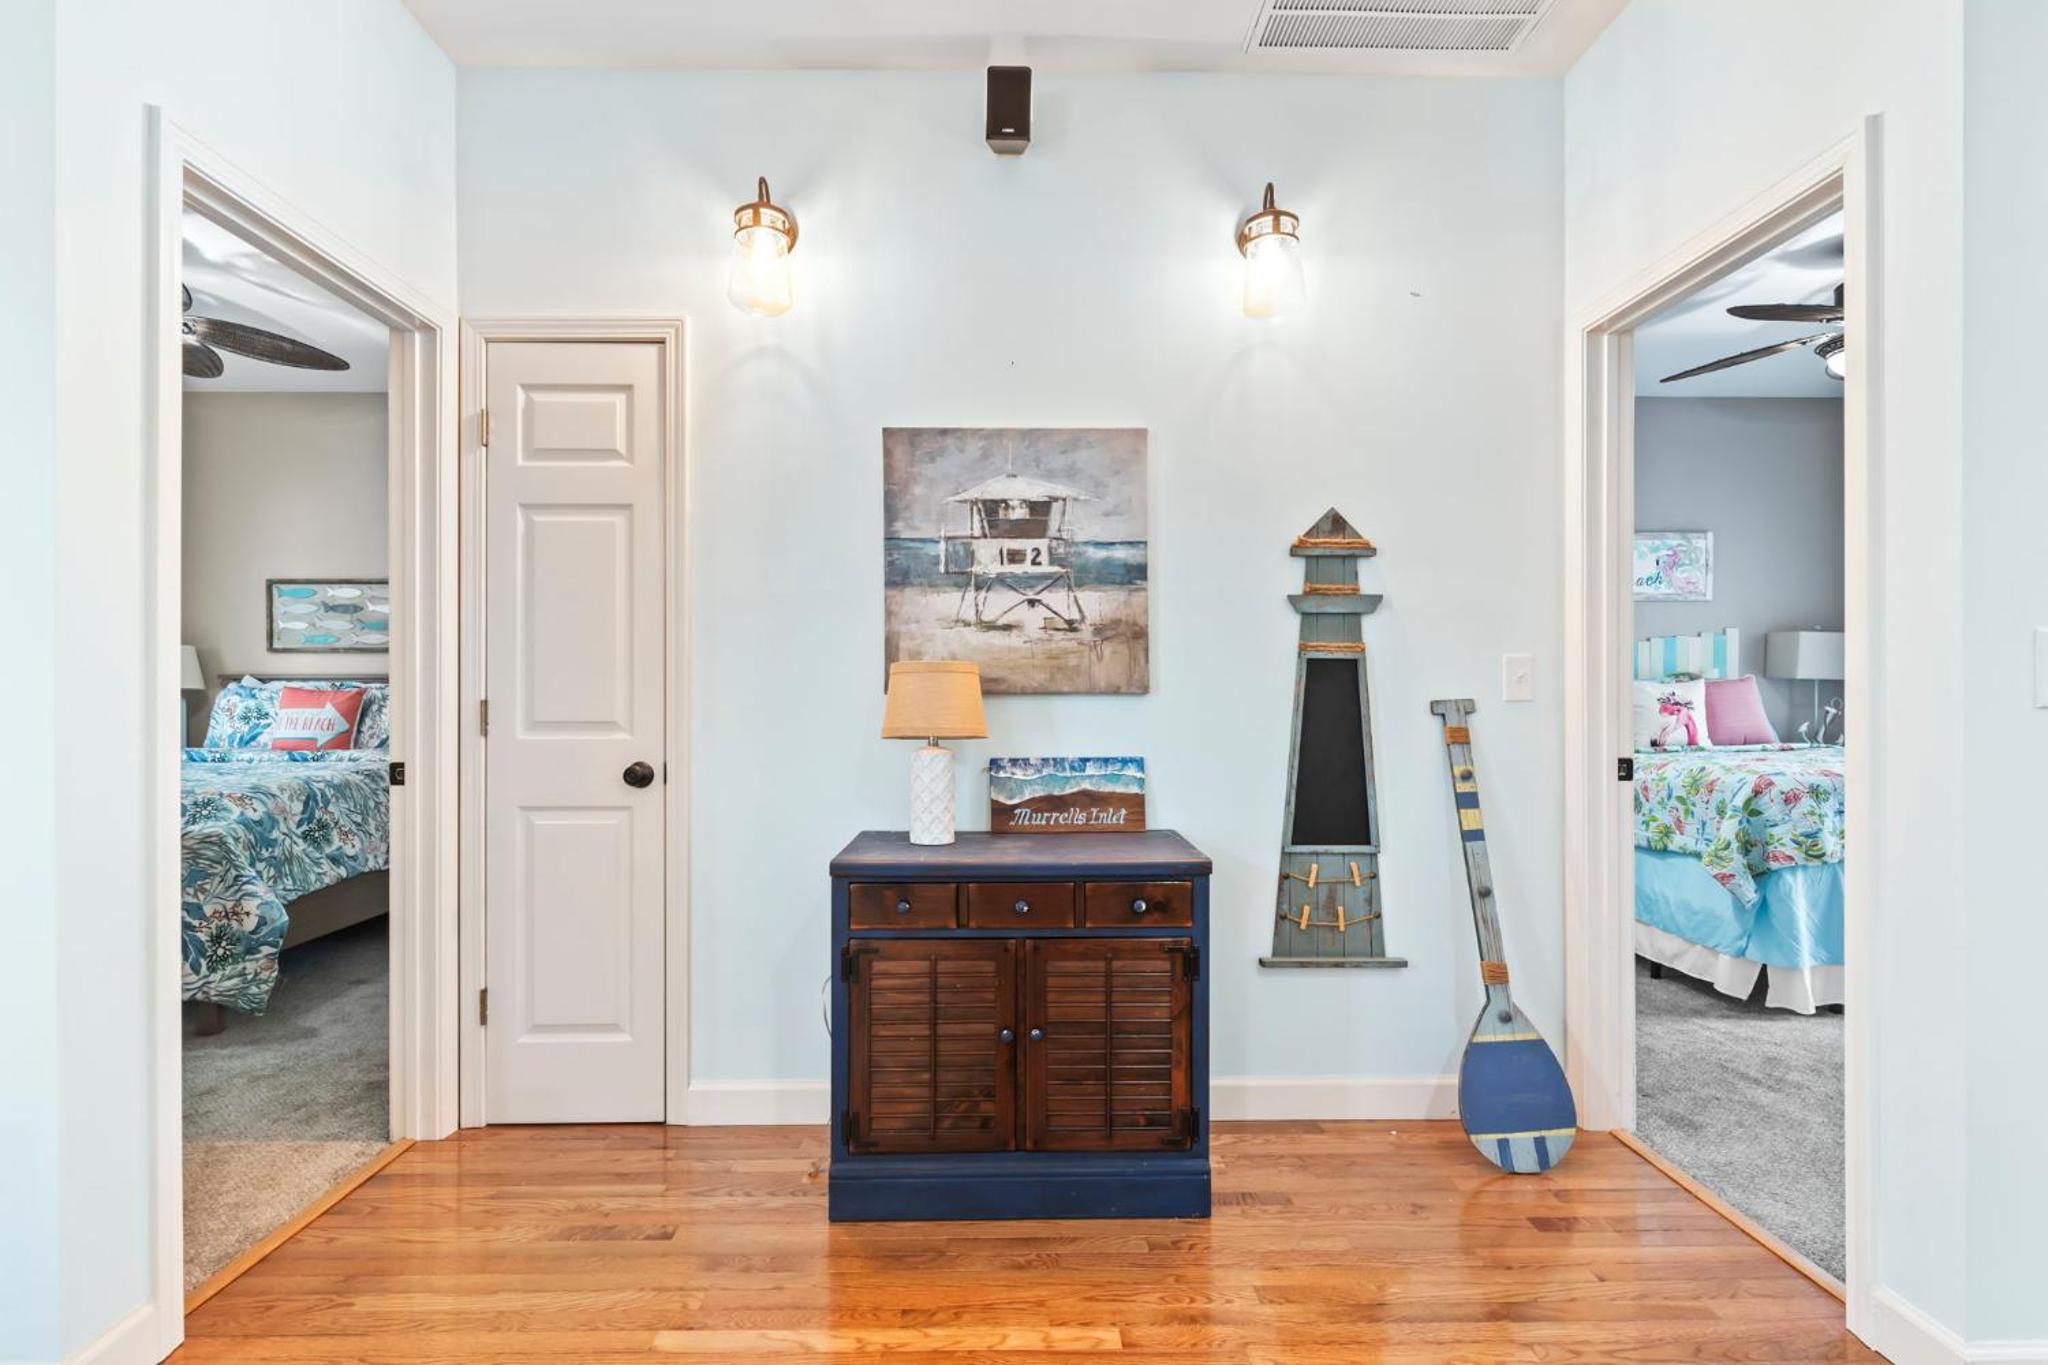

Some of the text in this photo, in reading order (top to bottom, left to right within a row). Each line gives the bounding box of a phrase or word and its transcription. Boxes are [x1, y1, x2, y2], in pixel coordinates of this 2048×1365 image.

[1030, 547, 1043, 566] 2
[302, 716, 336, 732] BEACH
[1009, 807, 1127, 826] Murrells Inlet
